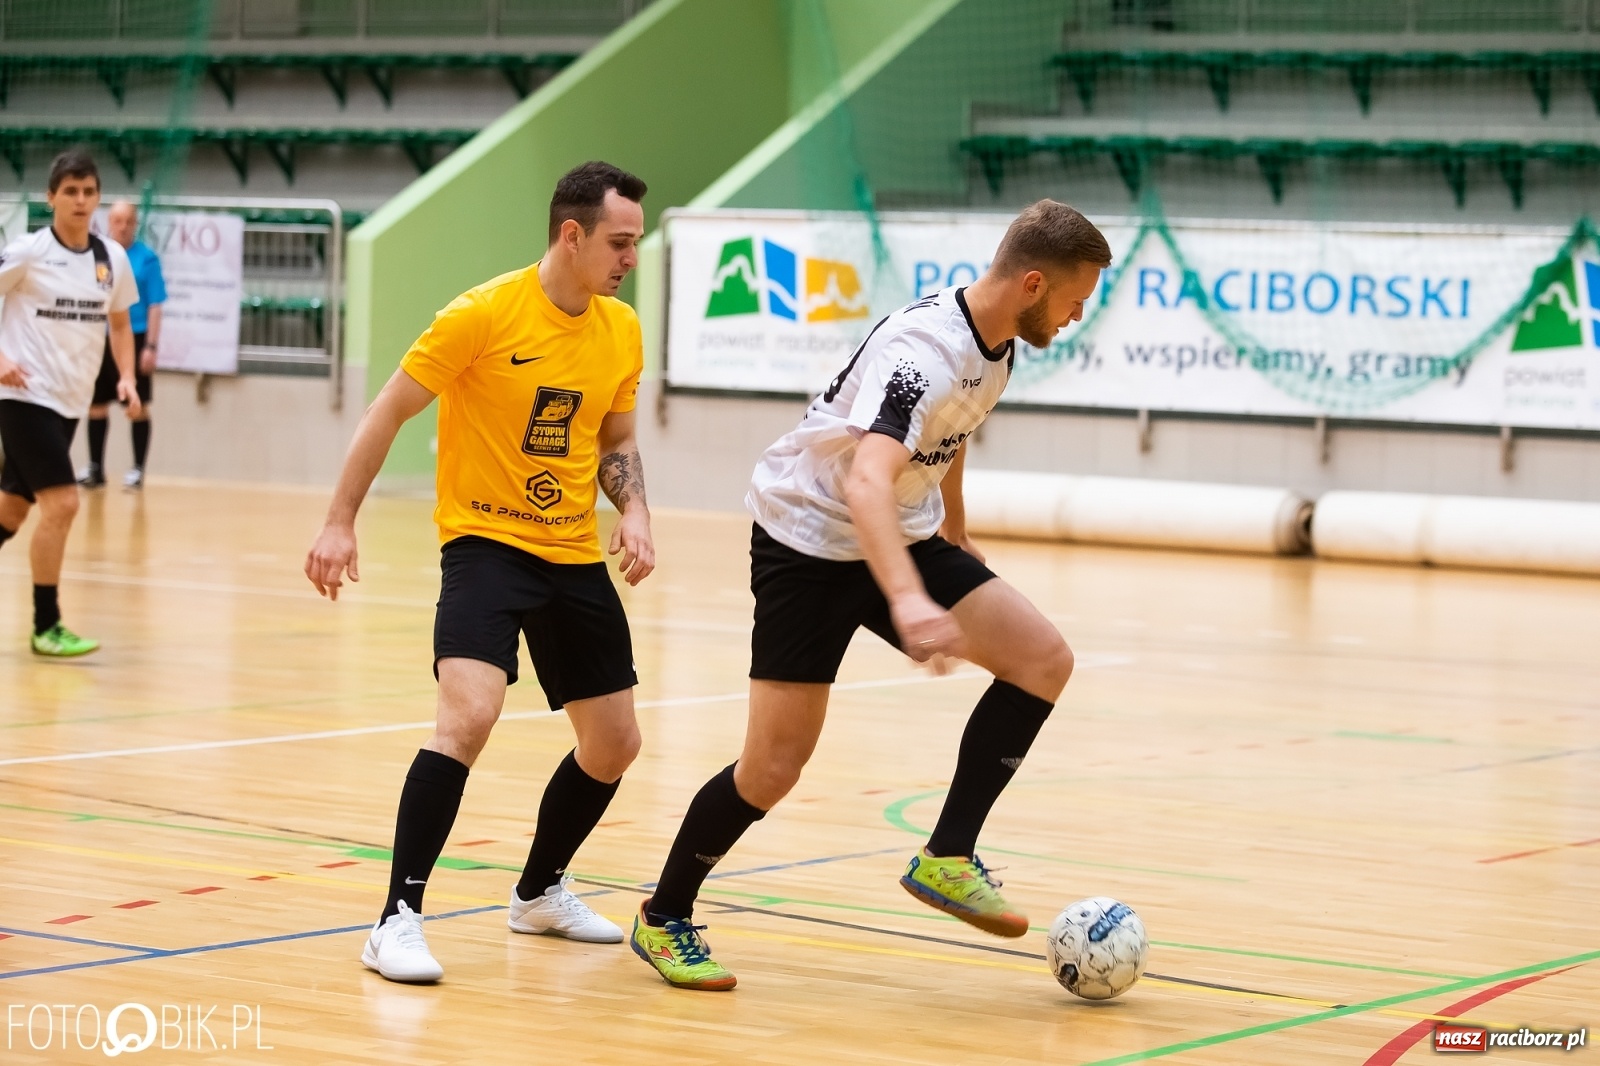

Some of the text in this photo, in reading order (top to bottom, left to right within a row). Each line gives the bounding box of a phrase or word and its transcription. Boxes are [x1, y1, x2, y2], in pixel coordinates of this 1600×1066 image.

[1137, 267, 1471, 318] RACIBORSKI
[1124, 333, 1335, 377] wspieramy,
[1503, 365, 1587, 389] powiat
[531, 426, 566, 437] STOPIW
[529, 436, 566, 447] GARAGE
[471, 500, 491, 513] SG
